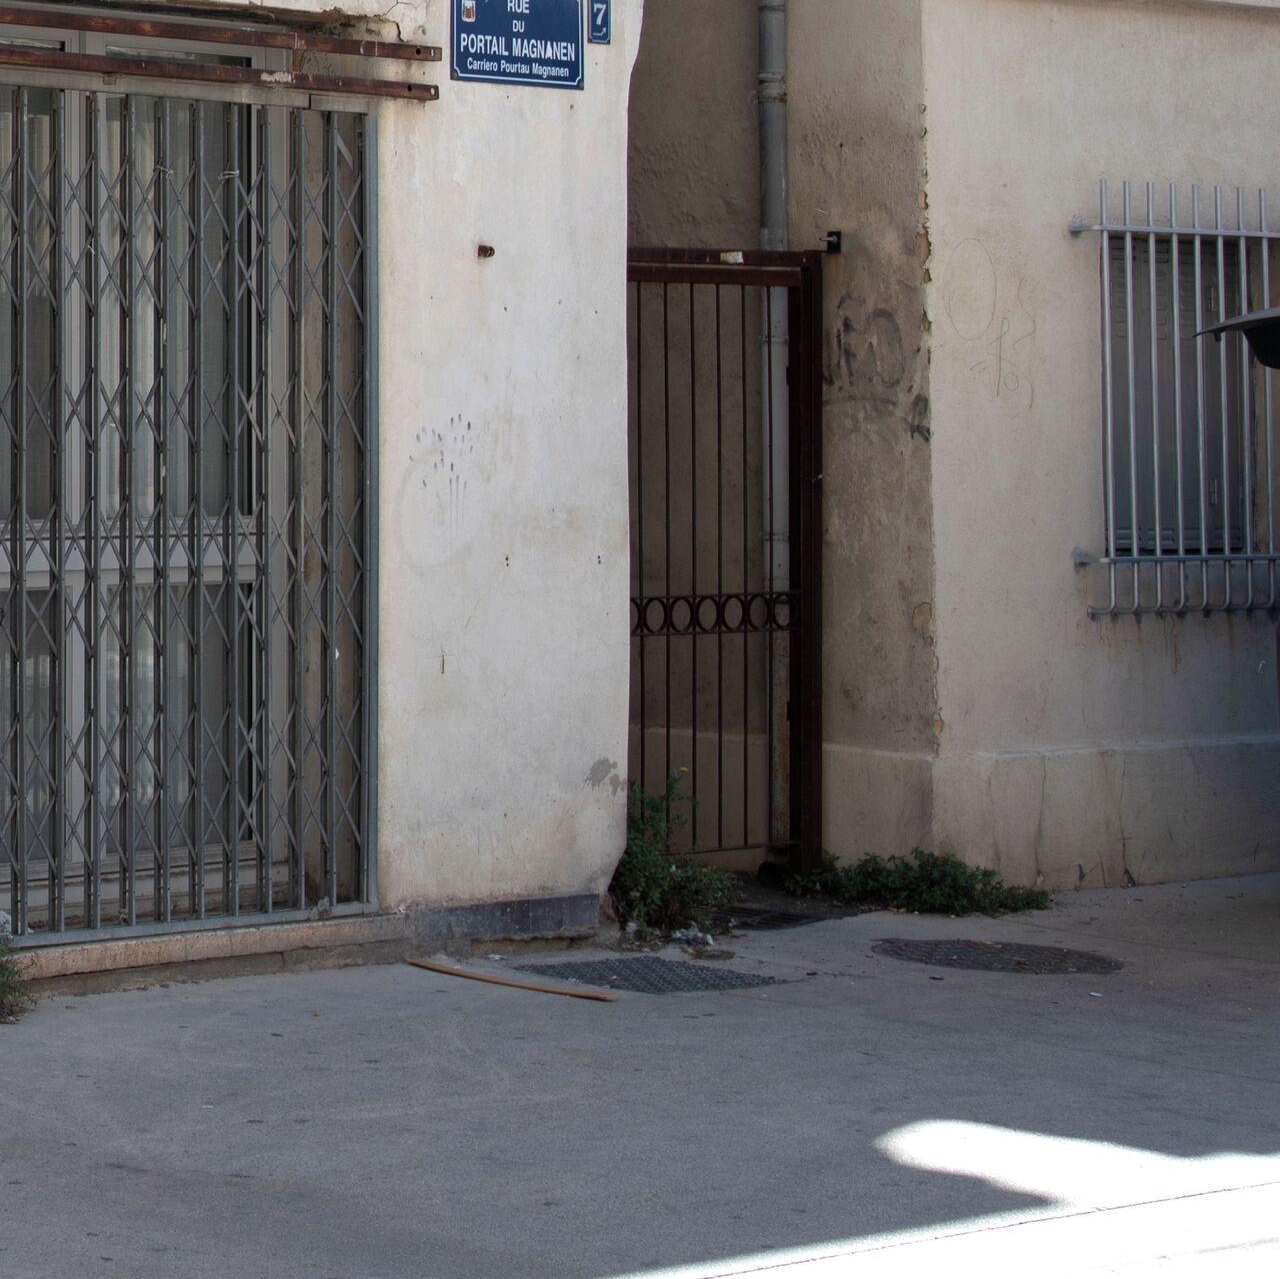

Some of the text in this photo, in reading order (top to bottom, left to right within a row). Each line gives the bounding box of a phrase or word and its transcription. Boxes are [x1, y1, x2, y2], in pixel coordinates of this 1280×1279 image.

[593, 2, 607, 26] 7
[512, 19, 525, 33] DU
[460, 33, 576, 62] PORTAIL MAGNANEN
[467, 57, 569, 78] Carriero Pourtau Magnanen
